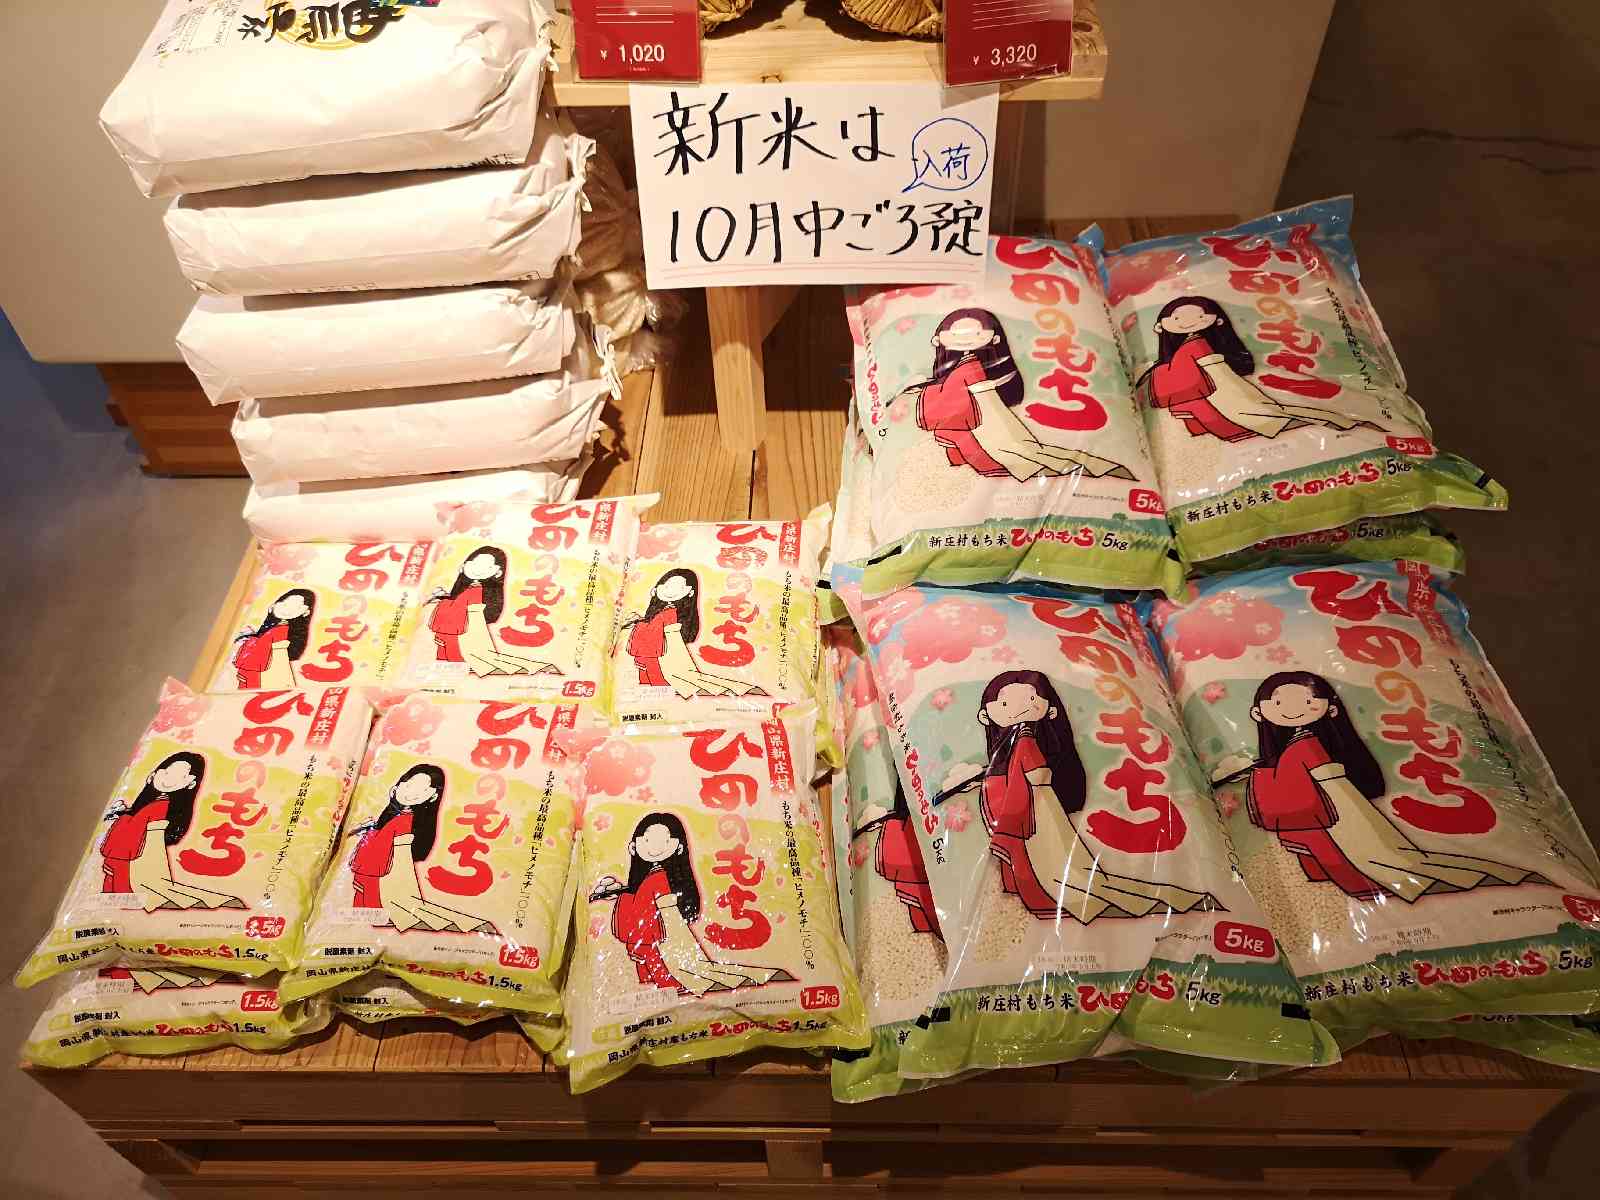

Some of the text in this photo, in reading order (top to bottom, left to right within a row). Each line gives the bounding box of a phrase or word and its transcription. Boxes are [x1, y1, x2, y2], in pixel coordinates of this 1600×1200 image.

[619, 44, 665, 64] 1,020
[990, 43, 1037, 67] 3,320
[652, 91, 896, 176] 新米は
[914, 143, 971, 181] 入荷
[996, 237, 1107, 431] ひめのもち
[1187, 490, 1272, 522] 新庄村もち米
[1386, 457, 1412, 475] 5kg
[500, 503, 590, 648] ひめのもち
[929, 533, 1007, 549] 新庄村もち米
[1102, 532, 1129, 551] 5kg
[300, 542, 403, 683] ひめのもち
[699, 524, 778, 668] ひめのもち
[1016, 595, 1187, 855] ひめのもち
[1290, 571, 1497, 834] ひめのもち
[179, 691, 315, 877] ひめのもち
[427, 700, 548, 896] ひめのもち
[683, 729, 772, 950] ひめのもち
[1225, 928, 1264, 952] 5kg
[1305, 950, 1594, 1002] 新庄村もち米 ひめのもち 5kg
[488, 976, 523, 992] 1.5kg
[803, 988, 839, 1007] 1.5kg
[976, 993, 1075, 1012] 新庄村もち米
[1186, 980, 1222, 1005] 5kg
